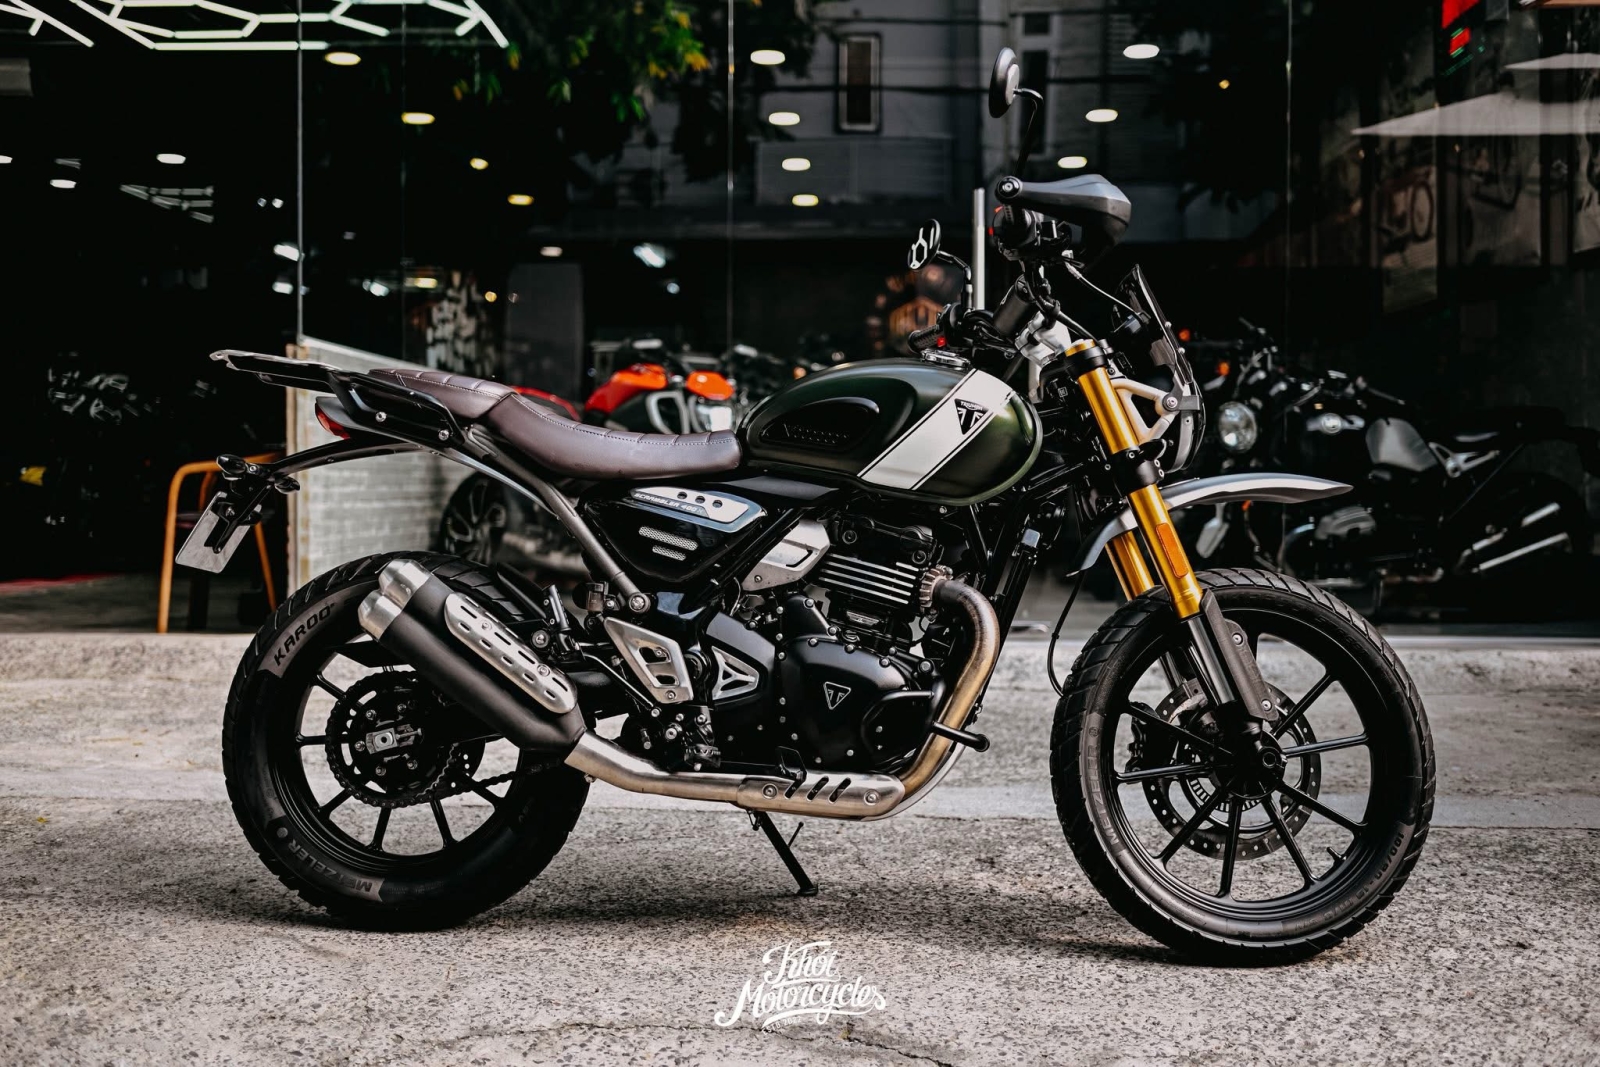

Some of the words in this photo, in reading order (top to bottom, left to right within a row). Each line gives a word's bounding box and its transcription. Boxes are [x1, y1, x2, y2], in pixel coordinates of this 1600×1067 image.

[634, 493, 679, 508] SCRAMBLER
[273, 604, 332, 667] KAROO
[1088, 744, 1120, 846] METZELER
[288, 839, 373, 893] METZELER
